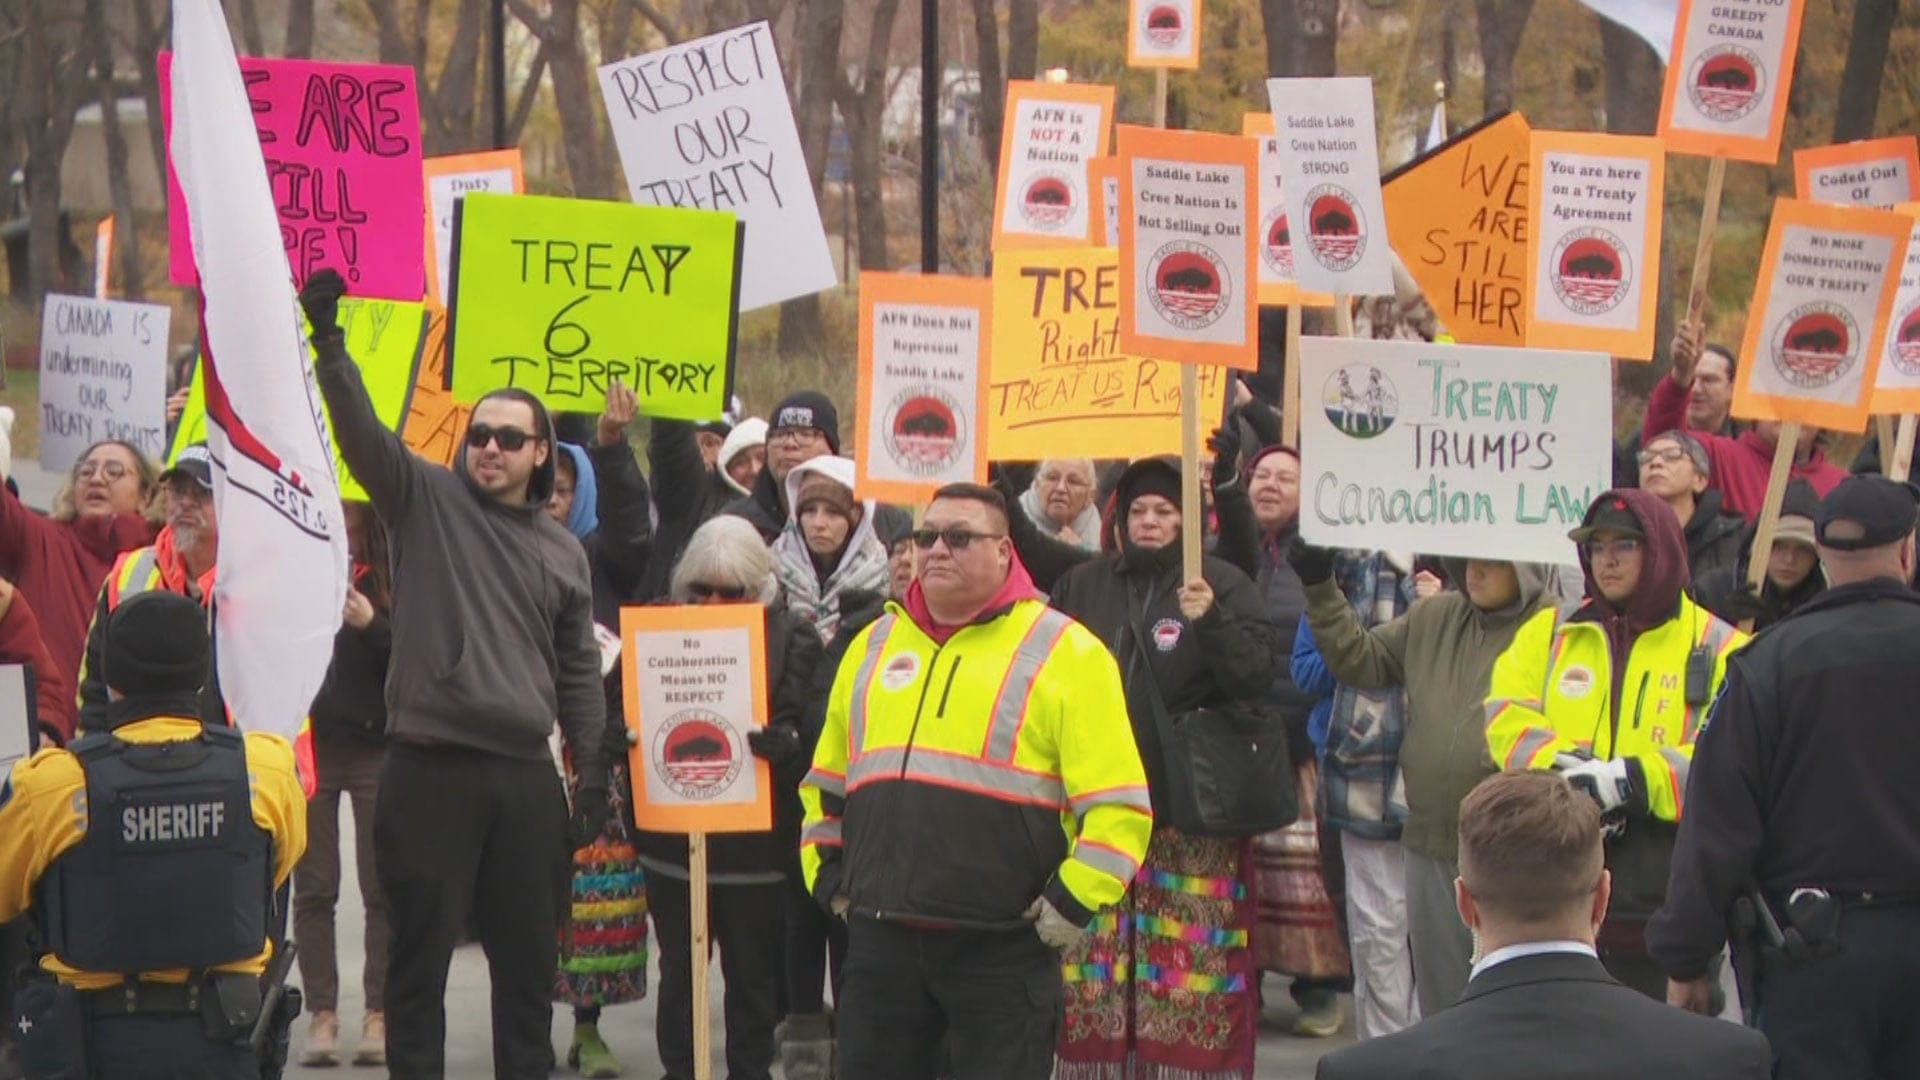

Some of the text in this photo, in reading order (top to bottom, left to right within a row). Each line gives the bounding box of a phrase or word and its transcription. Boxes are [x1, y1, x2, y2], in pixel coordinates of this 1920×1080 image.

[1712, 7, 1767, 23] GREEDY
[1708, 23, 1764, 41] CANADA
[611, 27, 764, 120] RESPECT
[296, 73, 410, 157] ARE
[1032, 108, 1084, 125] AFN is
[1287, 116, 1354, 129] Saddle Lake
[674, 105, 768, 165] OUR
[1030, 128, 1081, 145] NOT A
[1291, 139, 1316, 151] Cree
[1318, 139, 1357, 151] Nation
[1027, 148, 1079, 163] Nation
[1146, 166, 1230, 184] Saddle Lake
[1302, 161, 1349, 174] STRONG
[1461, 143, 1529, 210] WE
[1550, 160, 1641, 180] You are here
[1819, 166, 1898, 187] Coded Out
[264, 159, 368, 224] TILL
[451, 178, 491, 192] Duty
[640, 152, 782, 210] TREATY
[1140, 189, 1238, 210] Cree Nation Is
[1552, 184, 1637, 202] on a Treaty
[1852, 187, 1870, 201] Of
[1553, 203, 1633, 223] Agreement
[1139, 214, 1241, 236] Not Selling Out
[1469, 206, 1528, 243] ARE
[1811, 235, 1865, 251] NO MORE
[1420, 229, 1522, 281] STIL
[1783, 252, 1882, 273] DOMESTICATING
[1020, 265, 1118, 318] TRE
[1786, 274, 1869, 293] OUR TREATY
[1453, 277, 1522, 336] HER
[56, 302, 151, 345] CANADA IS
[544, 294, 591, 358] 6
[881, 312, 972, 331] AFN Does Not
[893, 340, 959, 355] Represent
[45, 344, 133, 401] undermining
[885, 365, 964, 382] Saddle Lake
[79, 383, 113, 413] OUR
[990, 369, 1087, 416] TREAT
[1094, 370, 1123, 396] US
[1418, 358, 1558, 423] TREATY
[42, 402, 92, 443] TREATY
[1404, 423, 1556, 472] TRUMPS
[1315, 471, 1495, 527] Canadian
[683, 639, 701, 650] No
[648, 655, 737, 669] Collaboration
[661, 672, 727, 686] Means NO
[665, 691, 724, 704] RESPECT
[122, 802, 225, 842] SHERIFF
